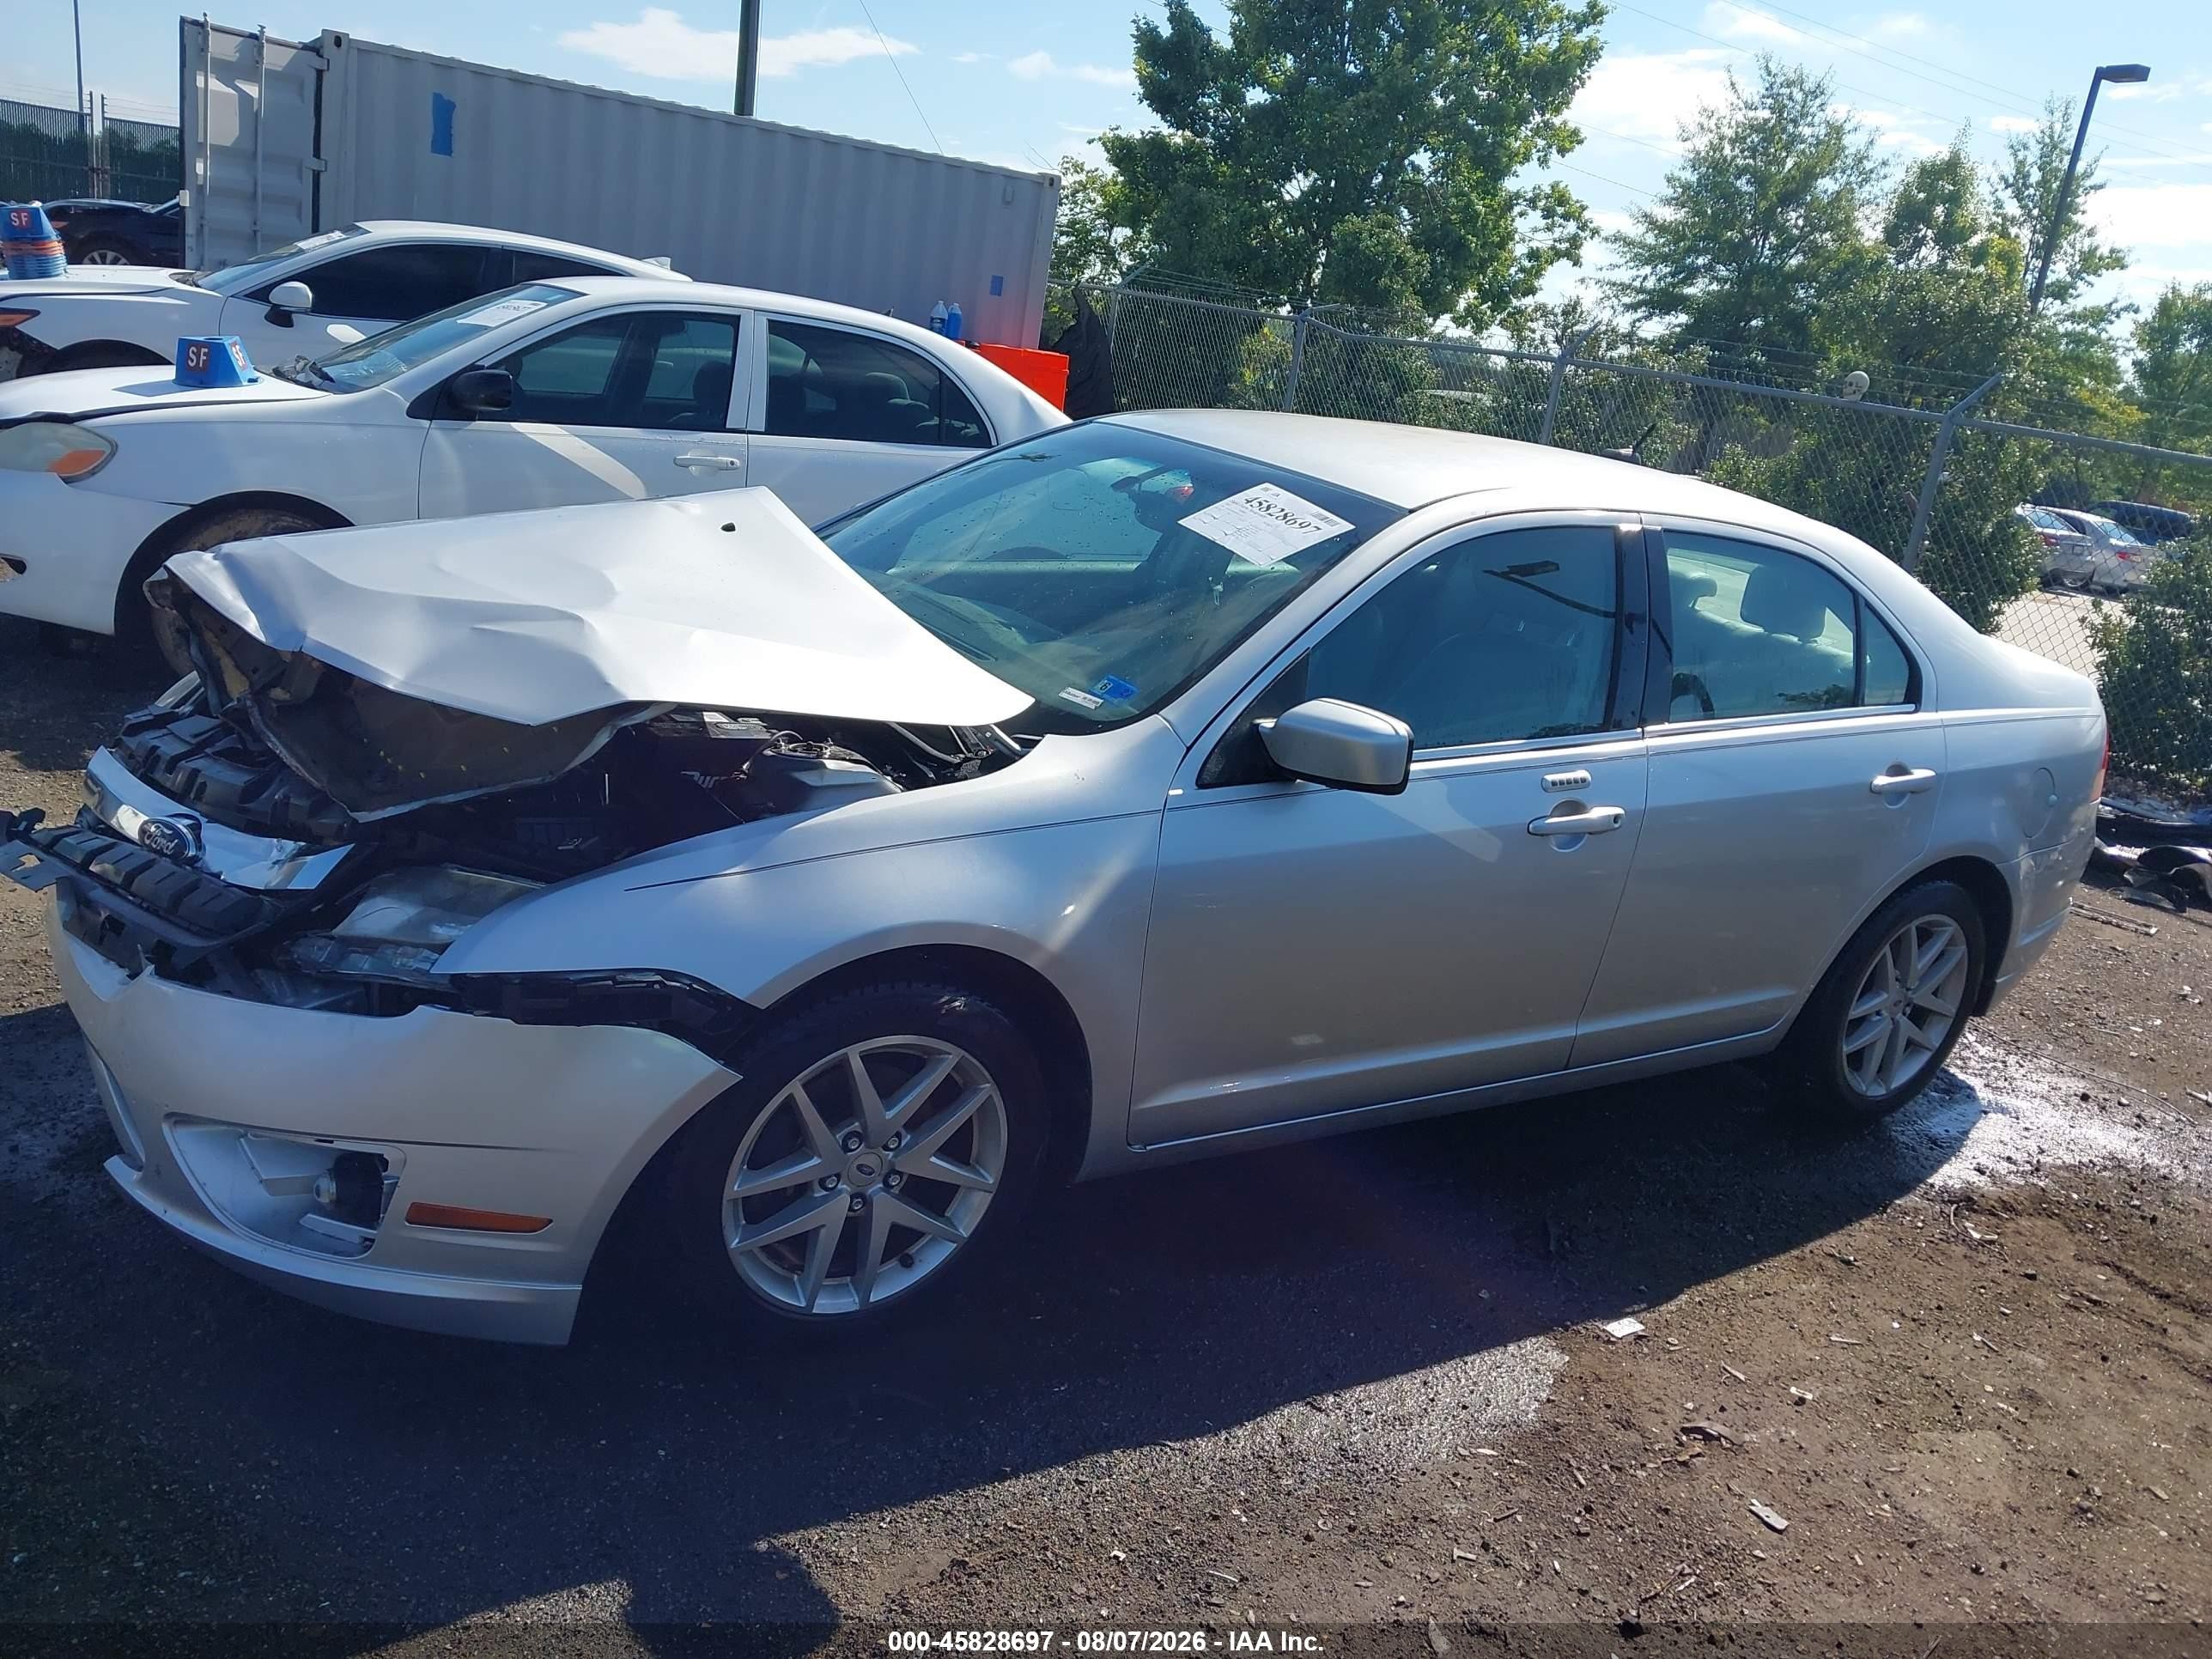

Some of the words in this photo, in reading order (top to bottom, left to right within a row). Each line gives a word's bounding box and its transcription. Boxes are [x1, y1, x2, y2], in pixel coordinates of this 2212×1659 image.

[10, 212, 28, 228] SF
[187, 347, 209, 368] SF
[1243, 496, 1322, 534] 45828697
[143, 823, 179, 855] Ford
